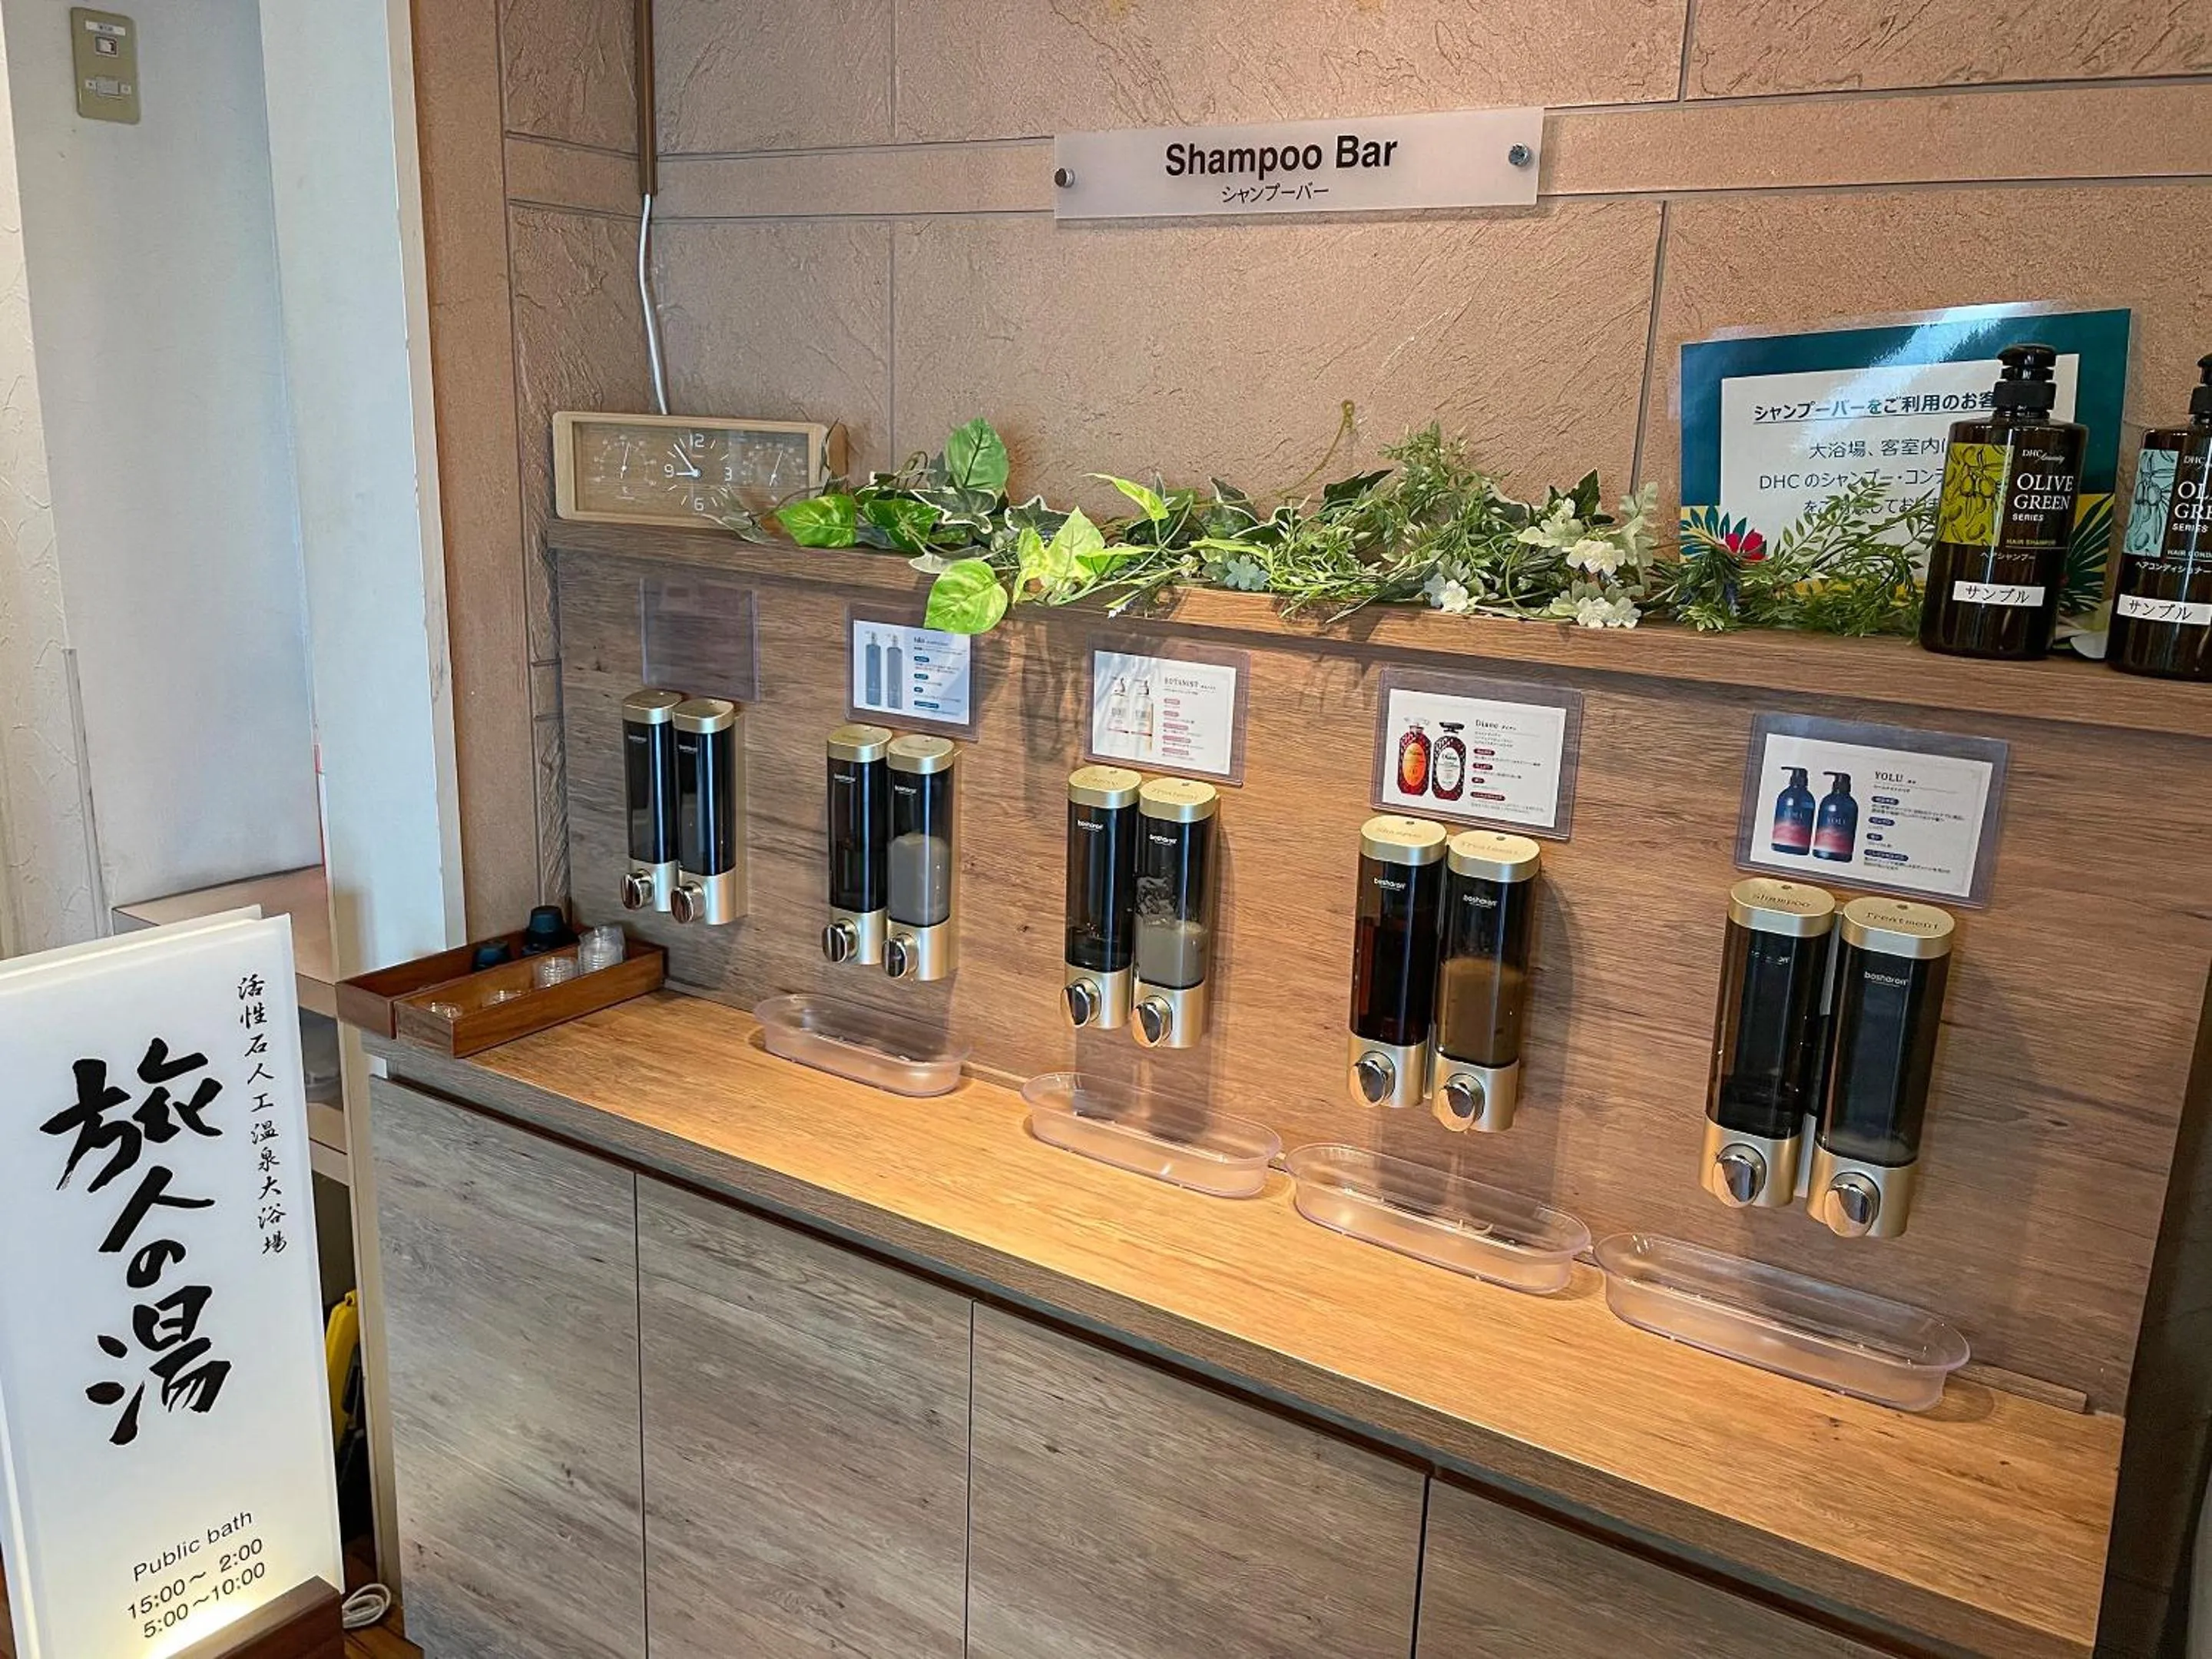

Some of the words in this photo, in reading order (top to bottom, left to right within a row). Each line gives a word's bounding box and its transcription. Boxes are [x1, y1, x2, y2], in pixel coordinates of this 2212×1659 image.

[1165, 142, 1323, 180] Shampoo
[1335, 134, 1398, 169] Bar
[1221, 182, 1330, 204] シャンプーバー
[690, 432, 706, 449] 12
[2022, 449, 2043, 458] DHC
[663, 463, 675, 478] 9
[724, 466, 733, 482] 3
[1759, 472, 1800, 490] DHC
[2016, 472, 2075, 492] OLIVE
[2177, 480, 2212, 500] OL
[693, 498, 704, 512] 6
[2013, 493, 2071, 511] GREEN
[2012, 512, 2045, 522] SERIES
[1965, 585, 2031, 604] サンプル
[2128, 598, 2194, 621] サンプル
[1874, 770, 1904, 783] YOLU
[237, 973, 287, 1255] 活性石人工温泉大浴場
[39, 1036, 232, 1445] 旅人の湯
[132, 1538, 201, 1582] Public
[207, 1511, 252, 1545] bath
[219, 1538, 263, 1573] 2:00
